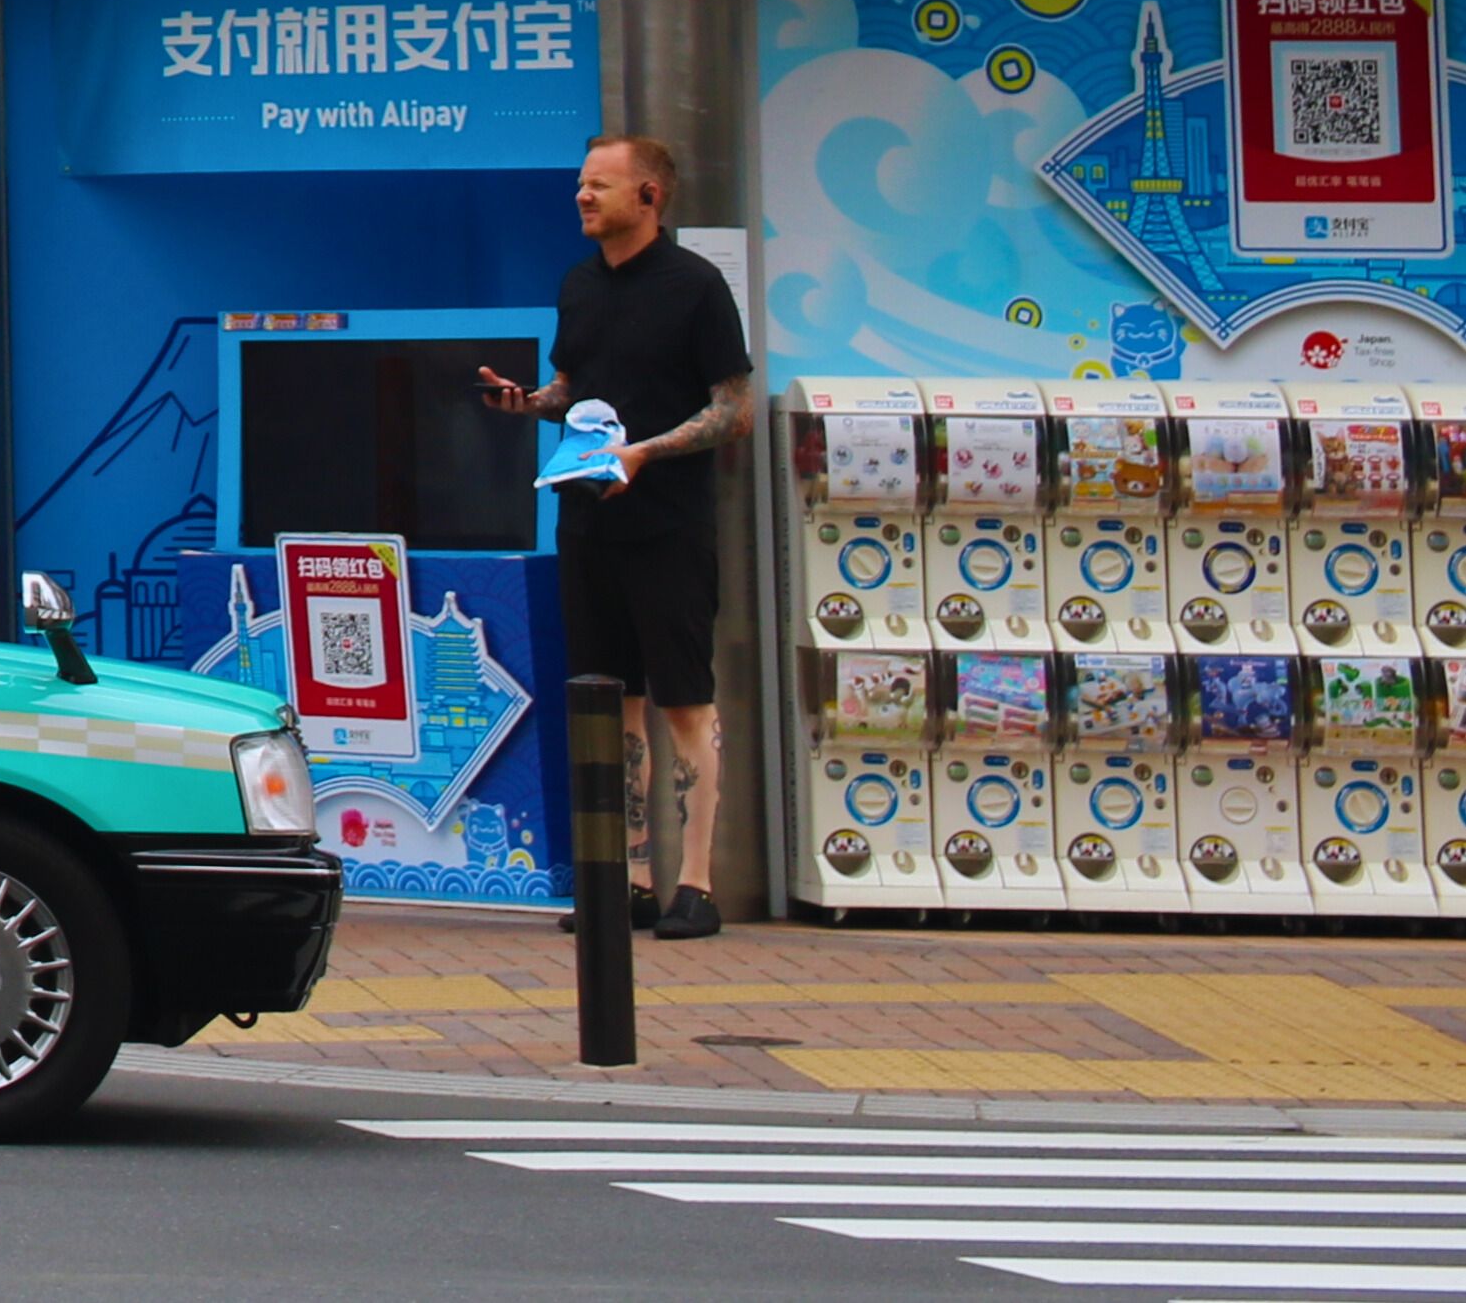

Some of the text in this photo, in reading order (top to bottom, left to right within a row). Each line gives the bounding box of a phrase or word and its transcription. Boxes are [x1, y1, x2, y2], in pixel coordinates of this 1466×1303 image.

[260, 98, 468, 135] Pay with Alipay
[297, 555, 385, 579] 扫码领红包
